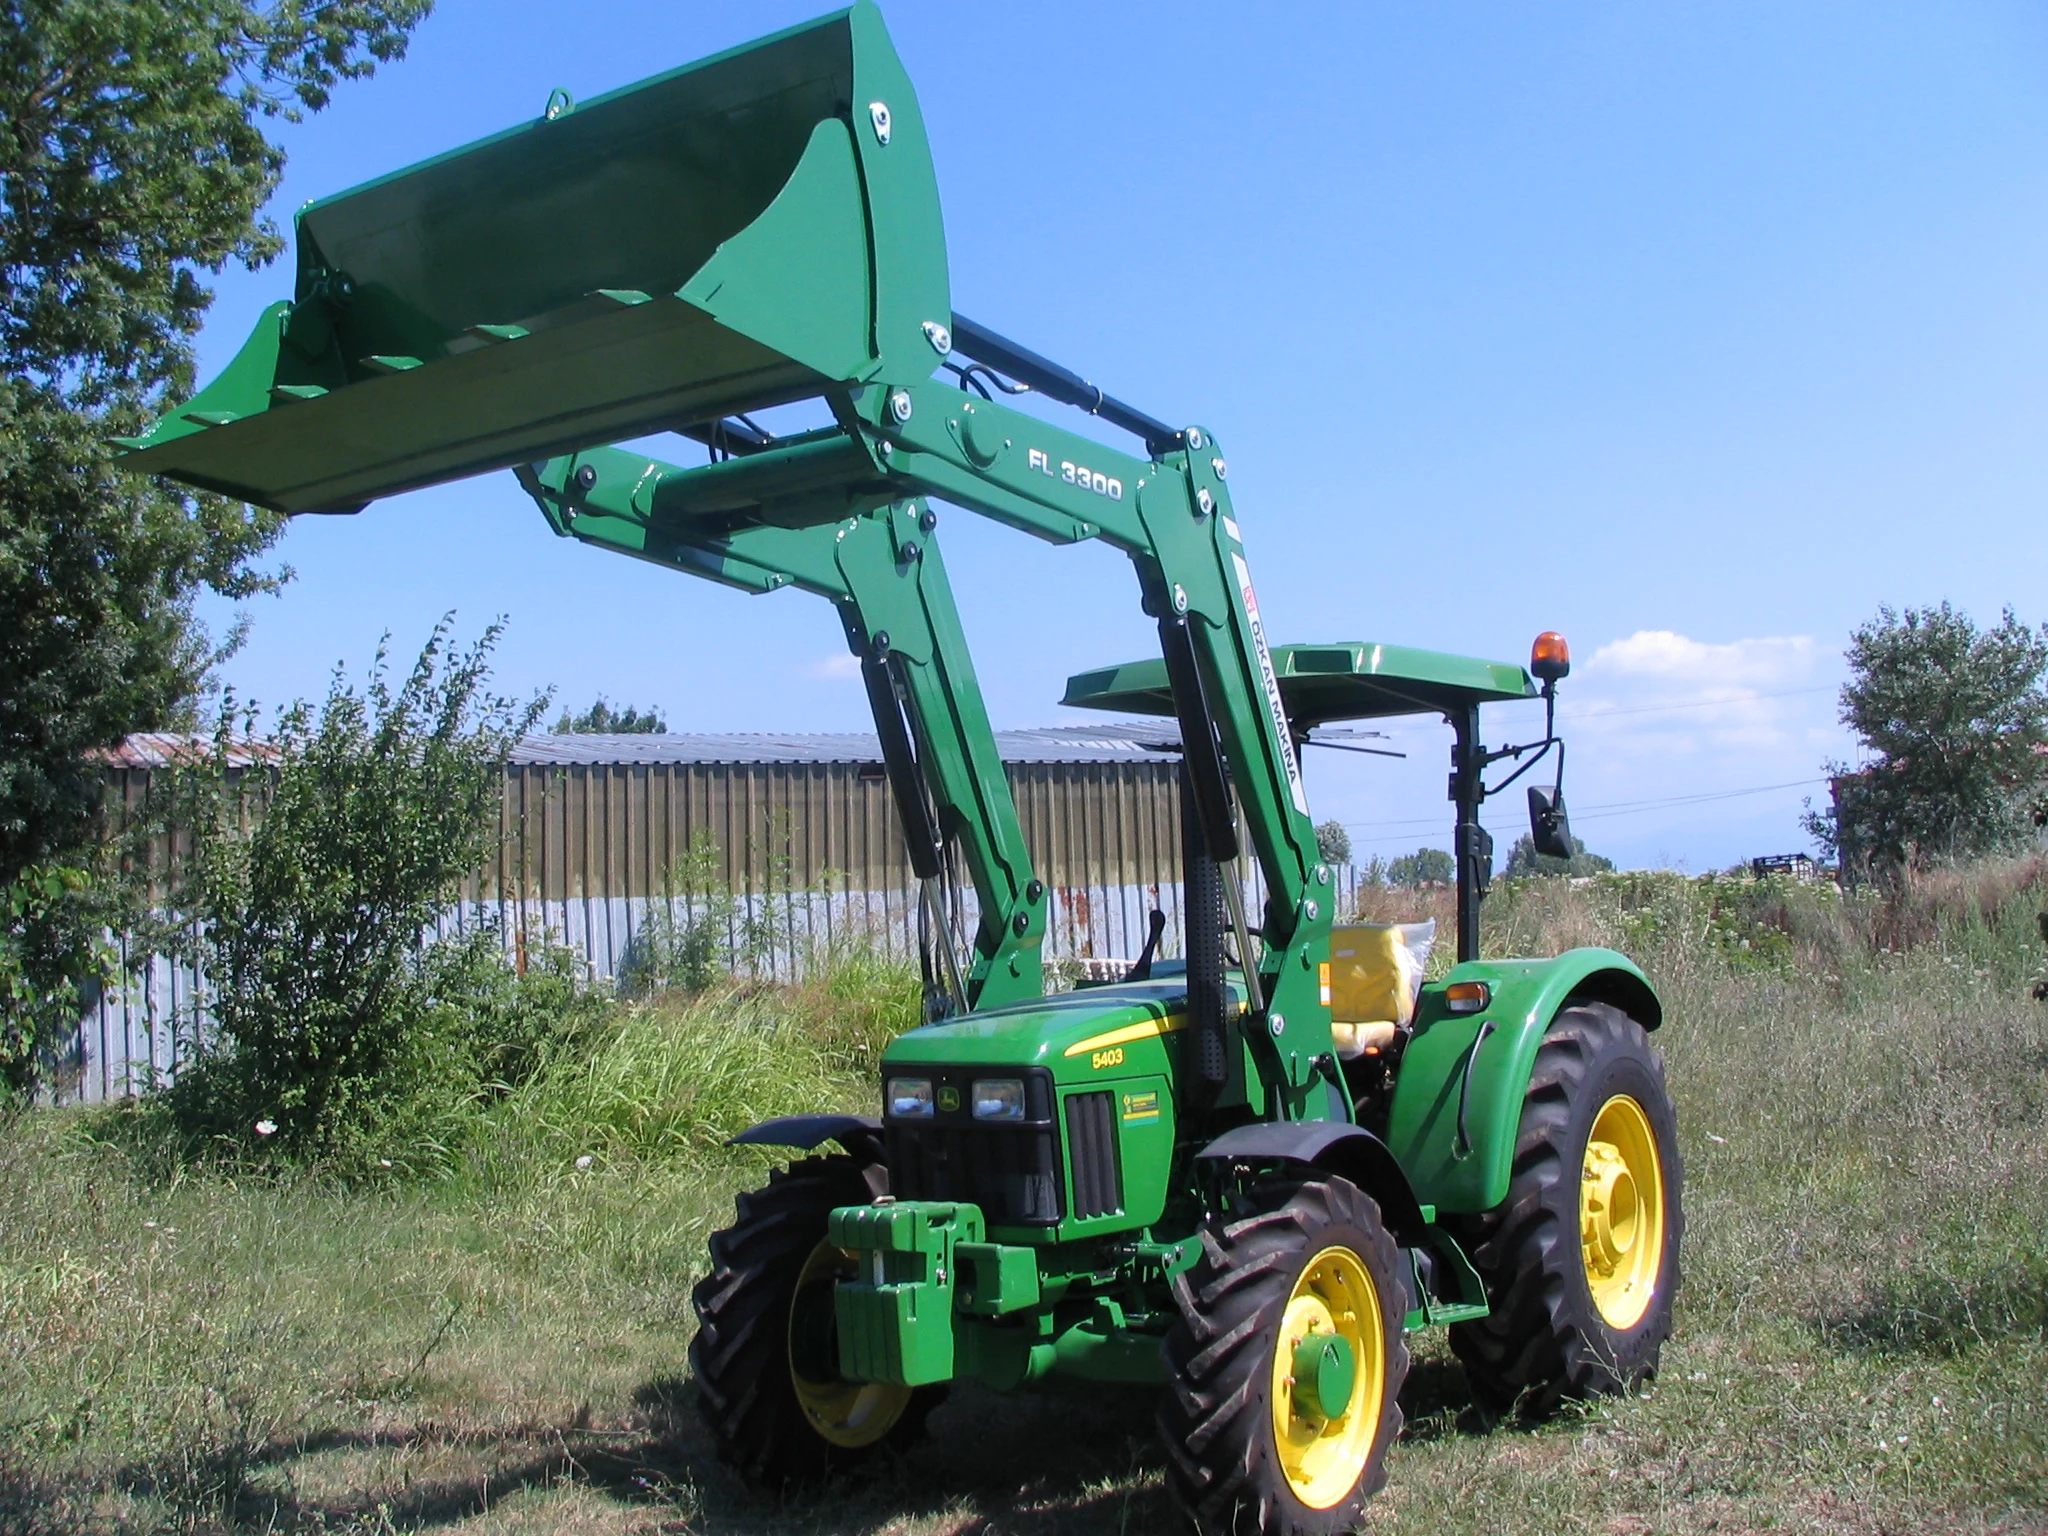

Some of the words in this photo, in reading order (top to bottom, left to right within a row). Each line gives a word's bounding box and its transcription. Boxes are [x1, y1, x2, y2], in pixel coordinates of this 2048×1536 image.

[1028, 448, 1054, 477] FL
[1061, 461, 1122, 501] 3300
[1092, 1048, 1123, 1069] 5403
